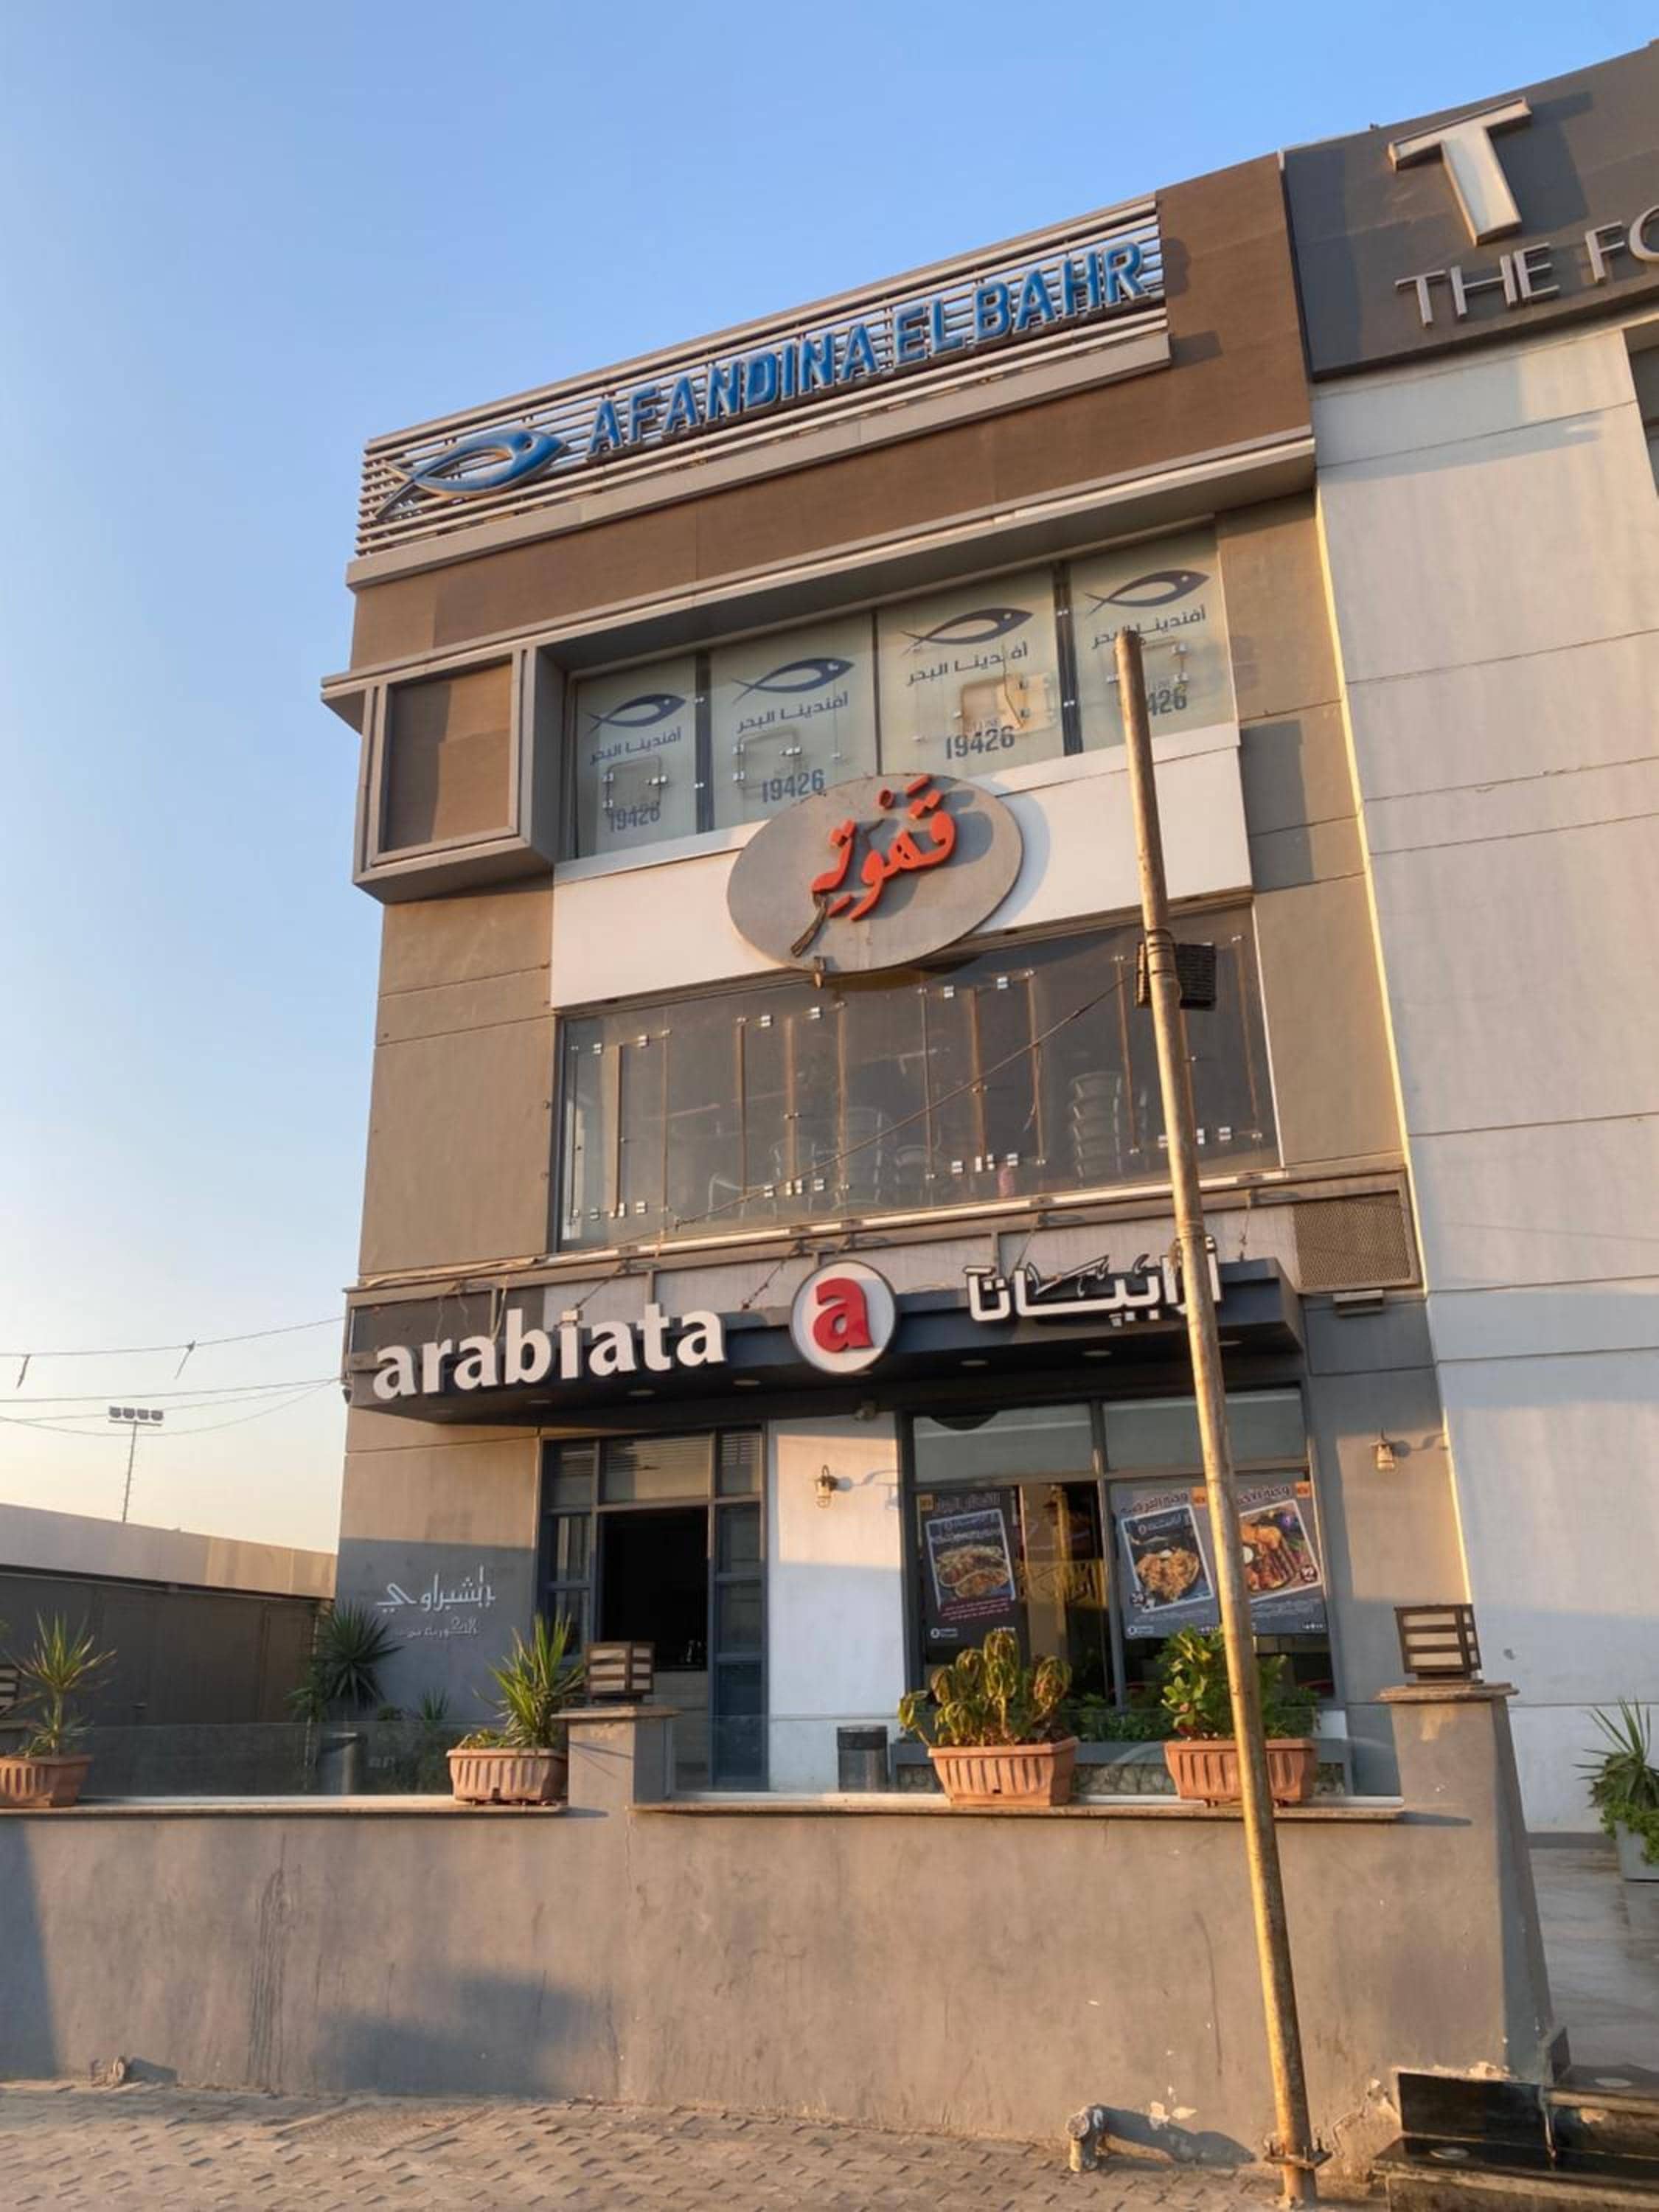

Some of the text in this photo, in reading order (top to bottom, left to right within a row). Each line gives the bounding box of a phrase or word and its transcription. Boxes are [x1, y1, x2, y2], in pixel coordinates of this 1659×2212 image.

[1394, 242, 1560, 329] THE
[588, 241, 1148, 457] AFANDINA EL BAHR
[907, 659, 948, 686] البحر
[1147, 684, 1188, 717] 426
[736, 709, 775, 733] البحر
[589, 743, 622, 765] البحر
[945, 725, 1015, 759] 19426
[762, 768, 826, 804] 19426
[608, 802, 661, 832] 19426
[812, 1276, 876, 1354] a
[372, 1302, 728, 1401] arabiata
